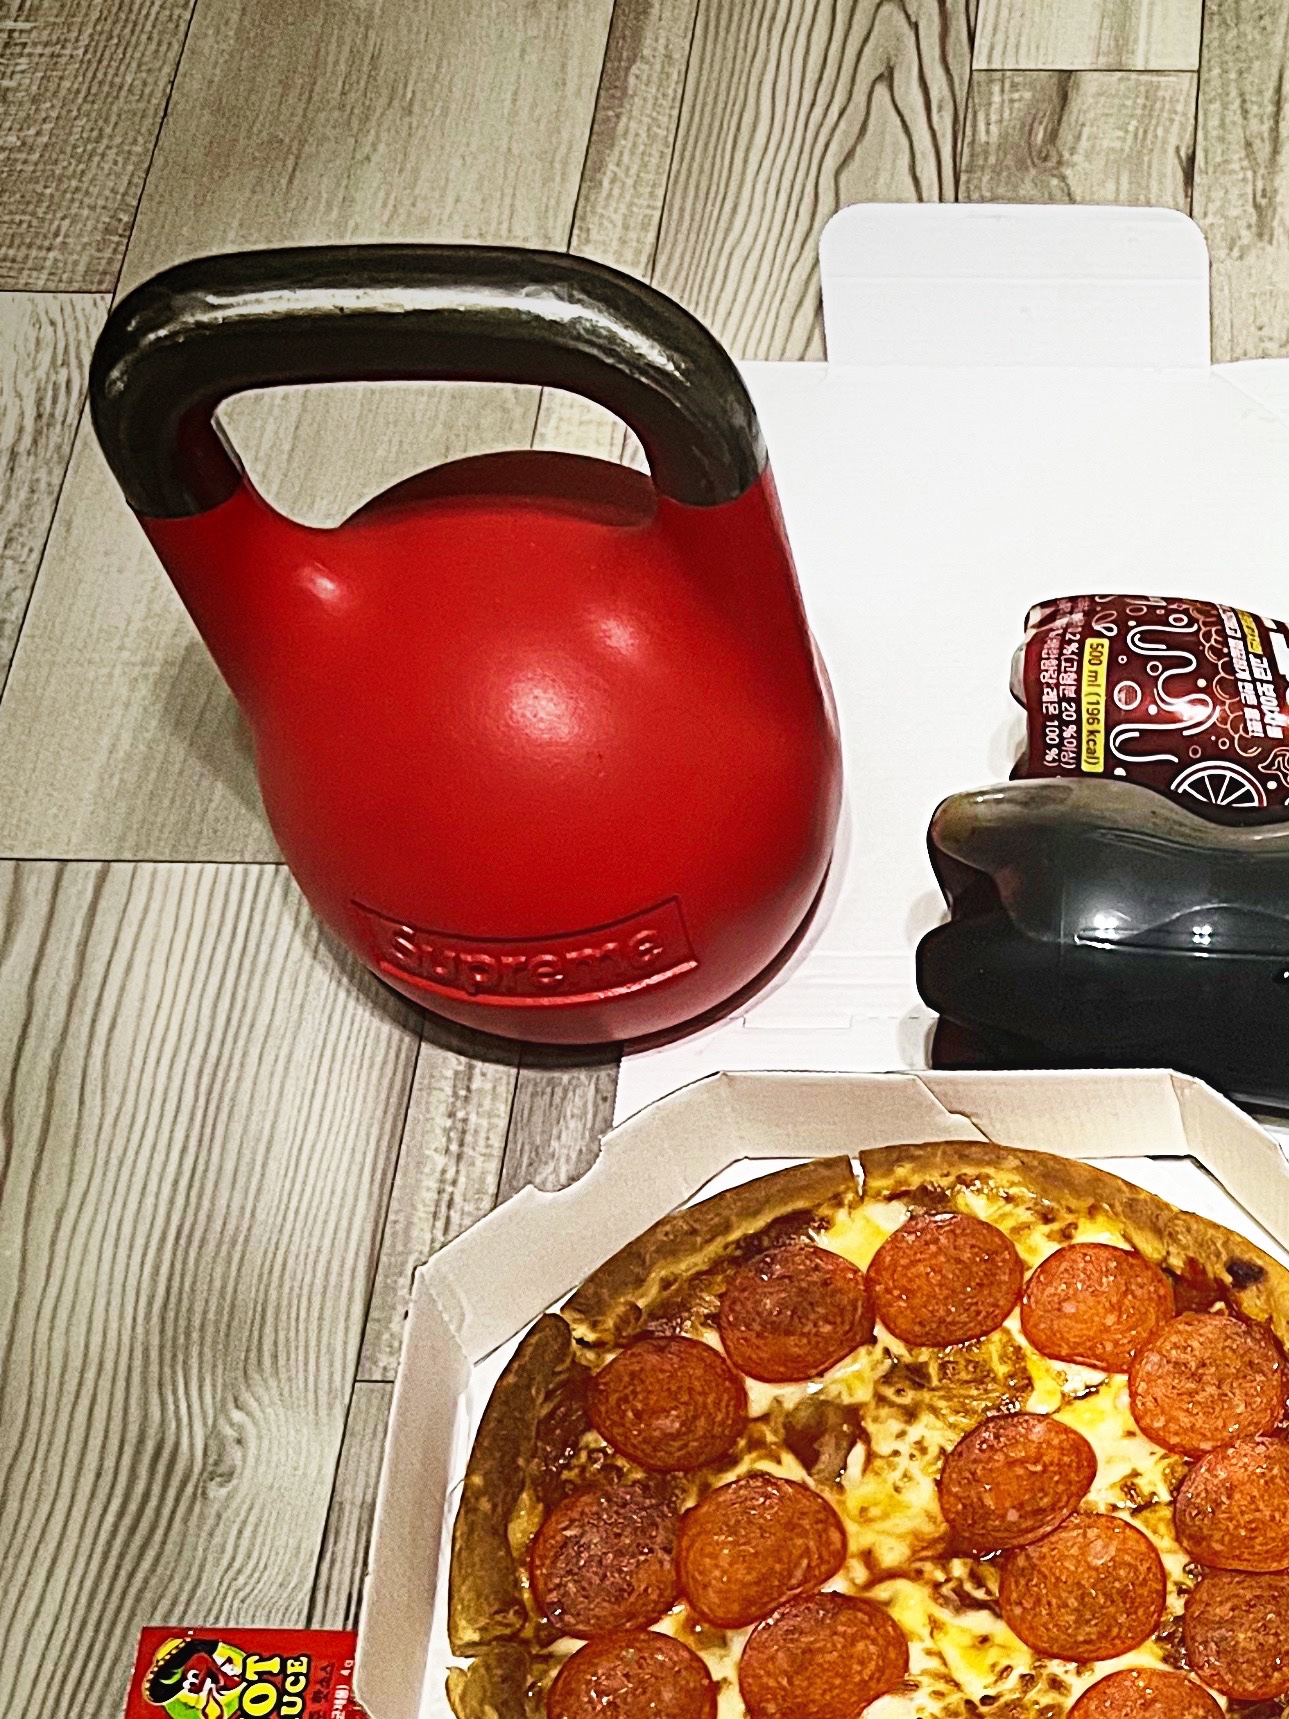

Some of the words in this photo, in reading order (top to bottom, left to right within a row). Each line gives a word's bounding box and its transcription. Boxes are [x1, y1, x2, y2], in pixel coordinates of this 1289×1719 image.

[1088, 643, 1104, 666] 500
[1087, 670, 1101, 687] ml
[1061, 702, 1076, 720] 20
[1085, 692, 1101, 725] (196
[1045, 720, 1060, 744] 100
[1043, 747, 1058, 767] %)
[1085, 730, 1100, 766] kcal)
